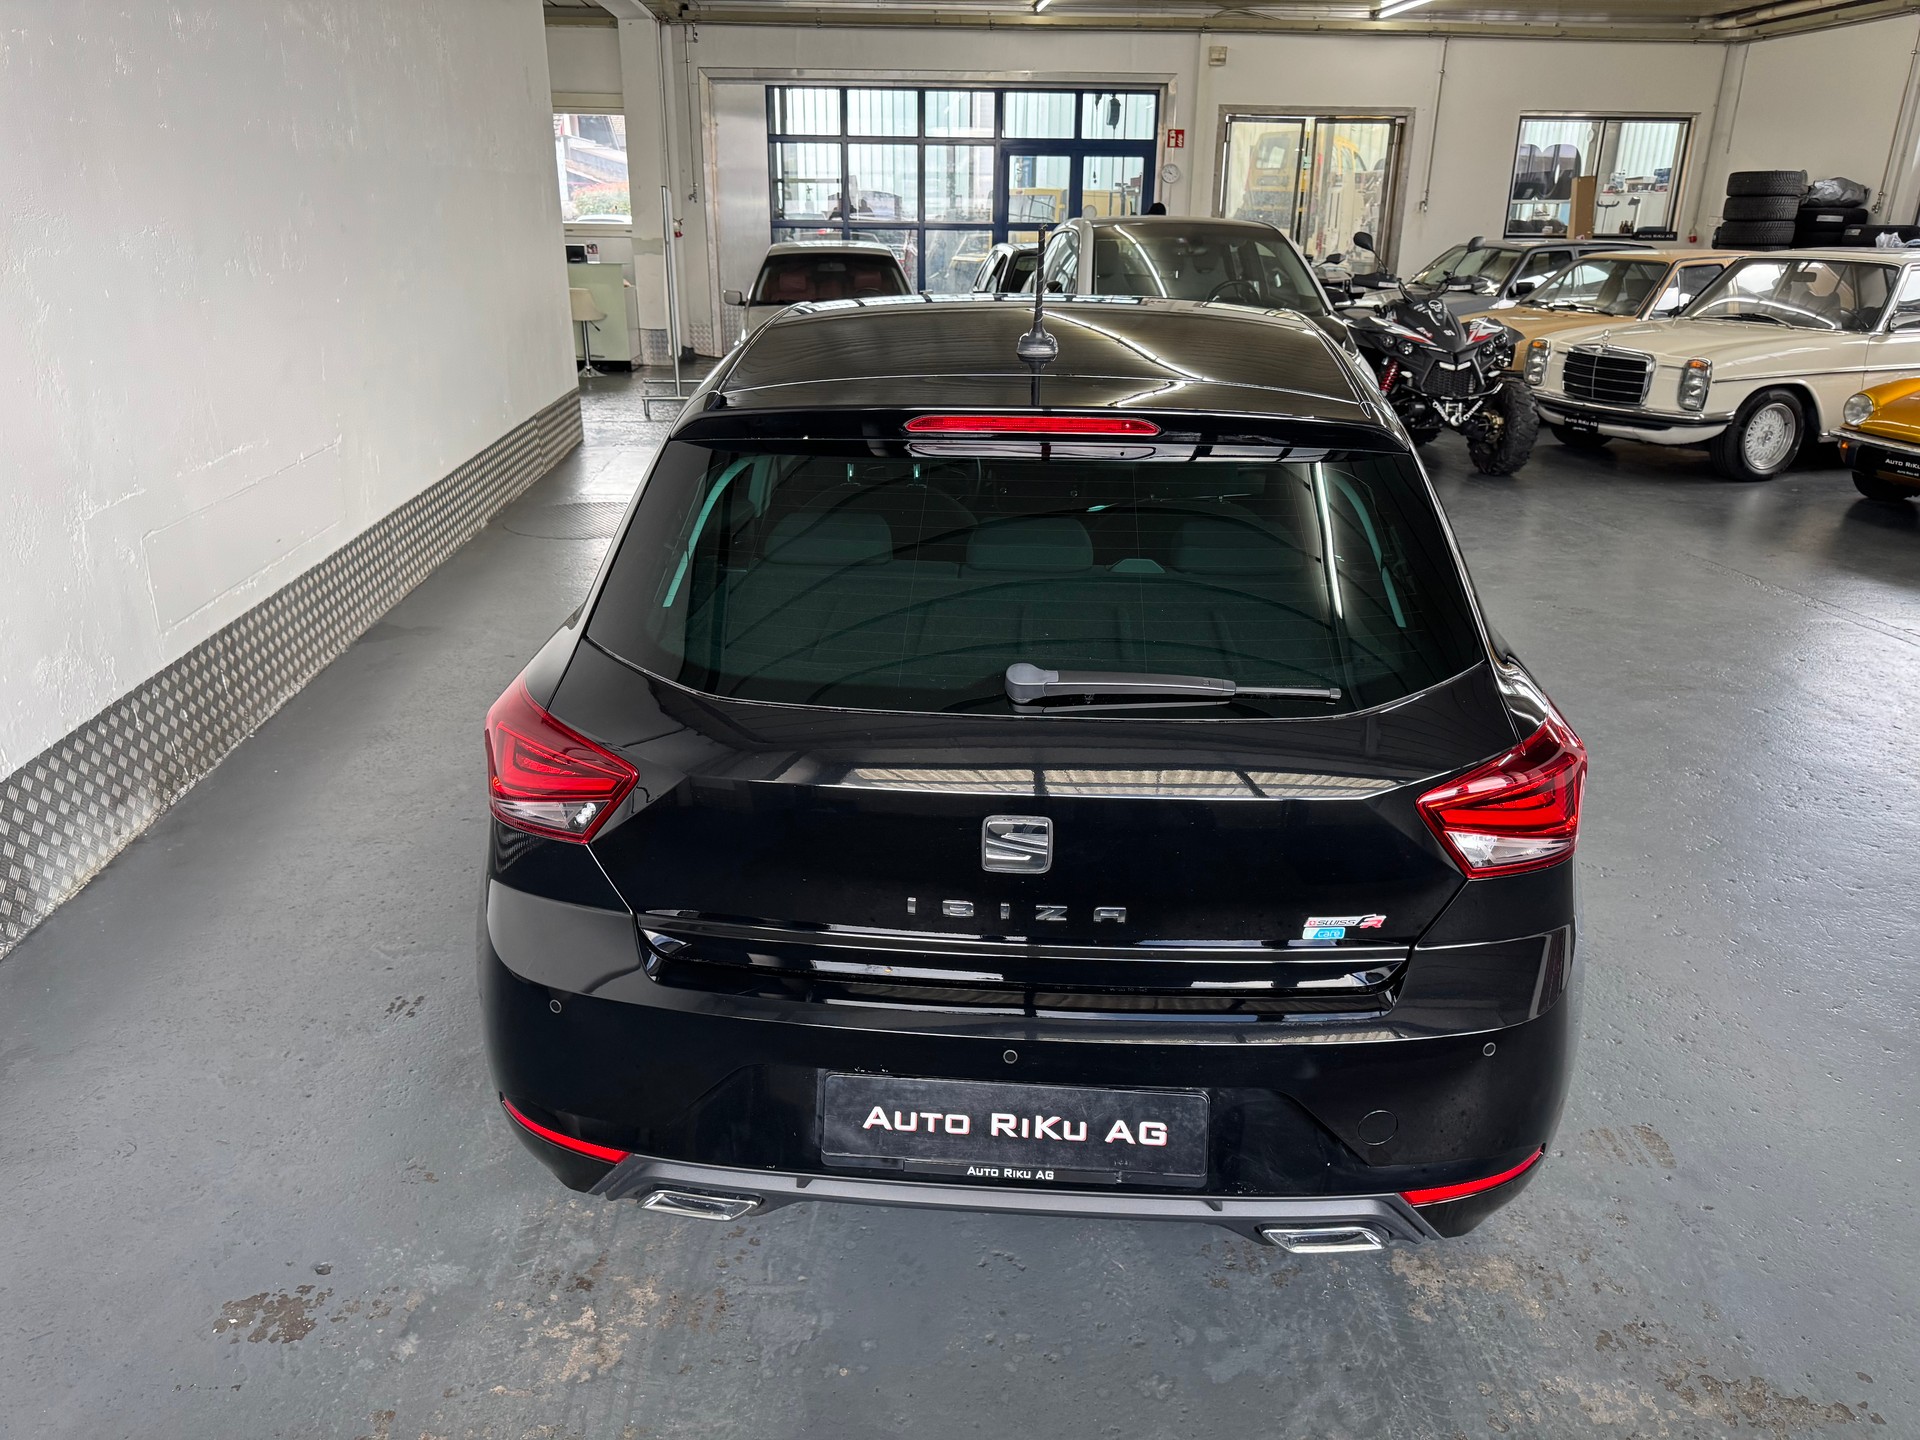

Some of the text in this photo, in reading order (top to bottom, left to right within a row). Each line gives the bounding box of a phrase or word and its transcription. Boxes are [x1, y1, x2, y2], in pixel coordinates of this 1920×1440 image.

[1885, 458, 1904, 467] AUTO
[907, 896, 1127, 923] IBIZA
[1316, 919, 1357, 927] SWISS
[862, 1105, 971, 1135] AUTO
[1104, 1119, 1168, 1147] AG
[966, 1165, 1055, 1180] AUTO RIKU AG
